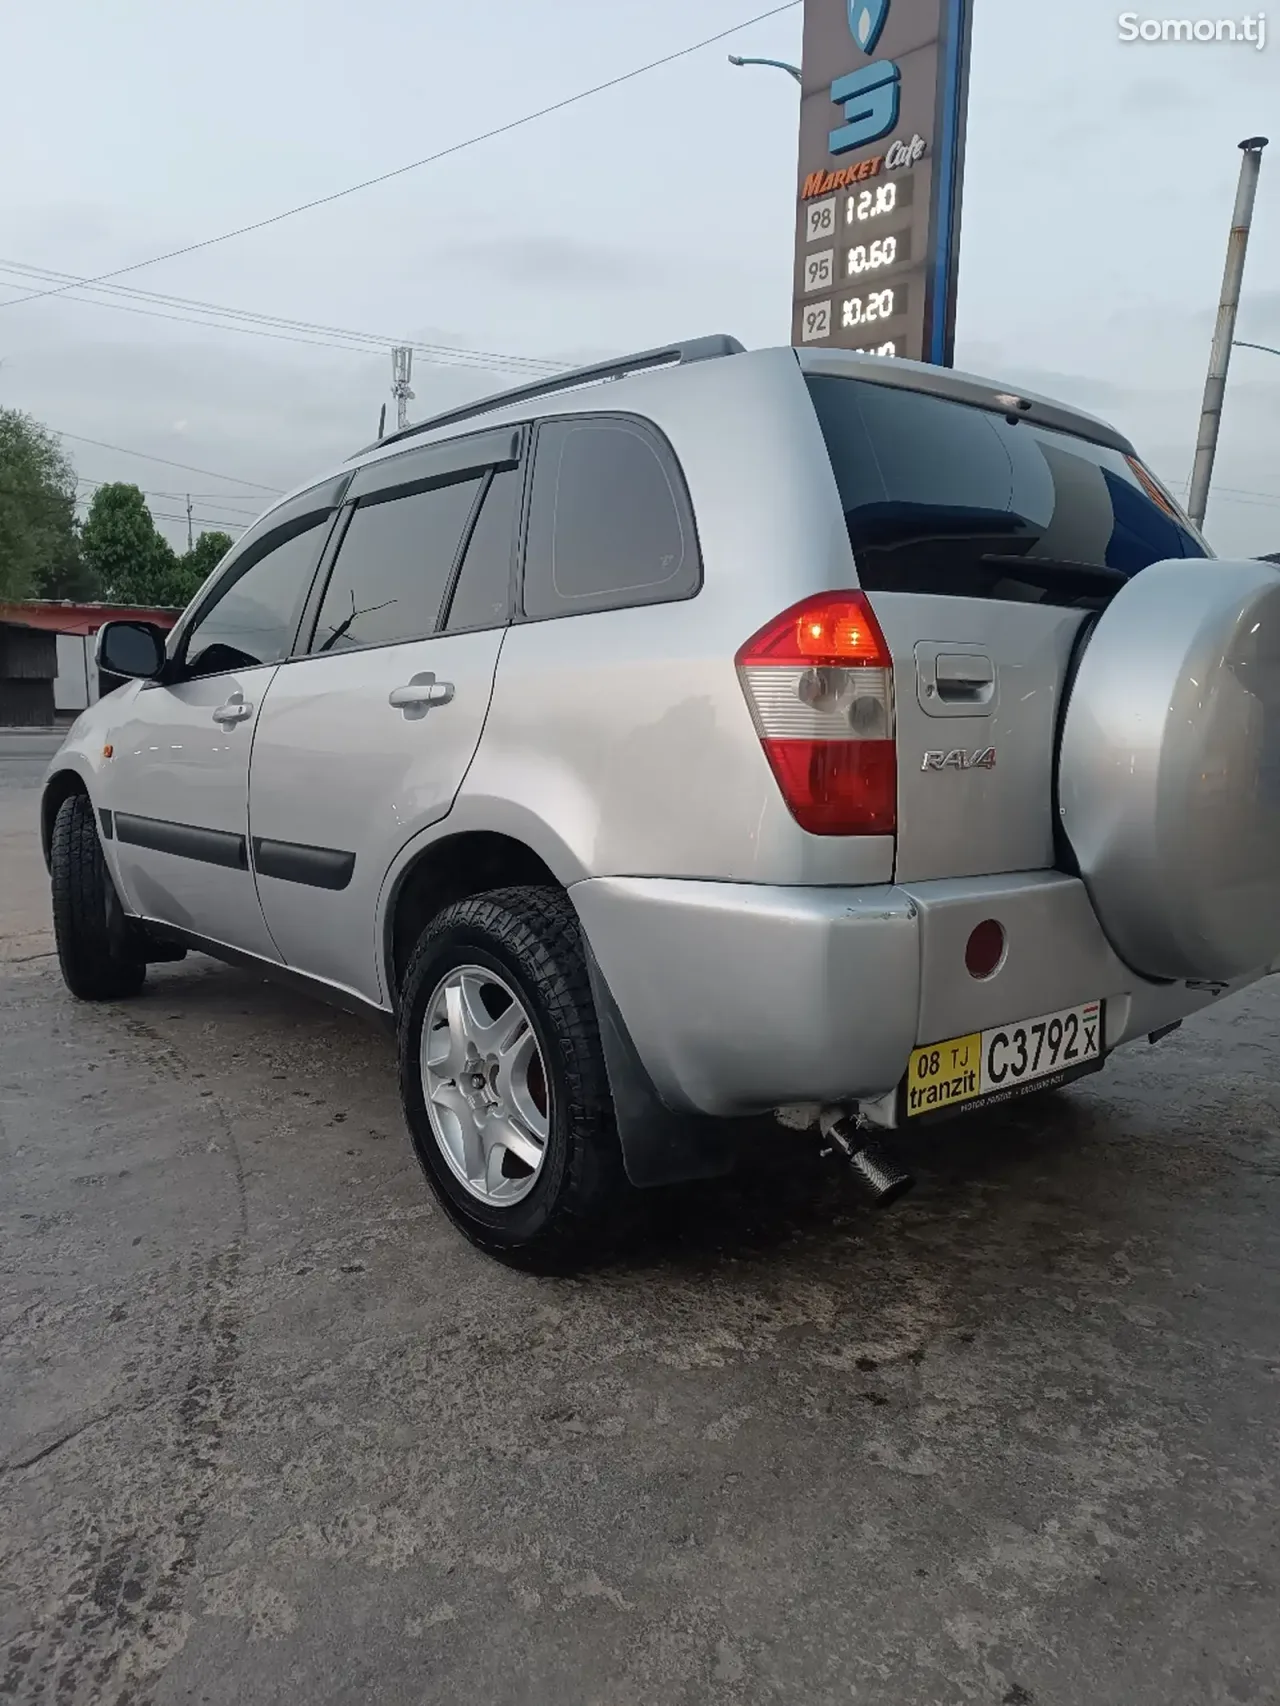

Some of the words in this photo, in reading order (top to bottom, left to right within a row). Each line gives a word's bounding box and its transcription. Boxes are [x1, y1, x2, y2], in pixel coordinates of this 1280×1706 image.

[802, 155, 884, 200] MARKET
[884, 134, 926, 170] Cafe
[810, 210, 832, 234] 98
[846, 182, 896, 225] 12.10
[808, 260, 829, 283] 95
[848, 236, 896, 275] 10.60
[806, 312, 827, 335] 92
[842, 288, 894, 327] 10.20
[920, 746, 996, 771] RAV4
[917, 1050, 940, 1079] 08
[951, 1046, 969, 1069] TJ
[988, 1013, 1079, 1084] C3792
[910, 1070, 976, 1109] tranzit
